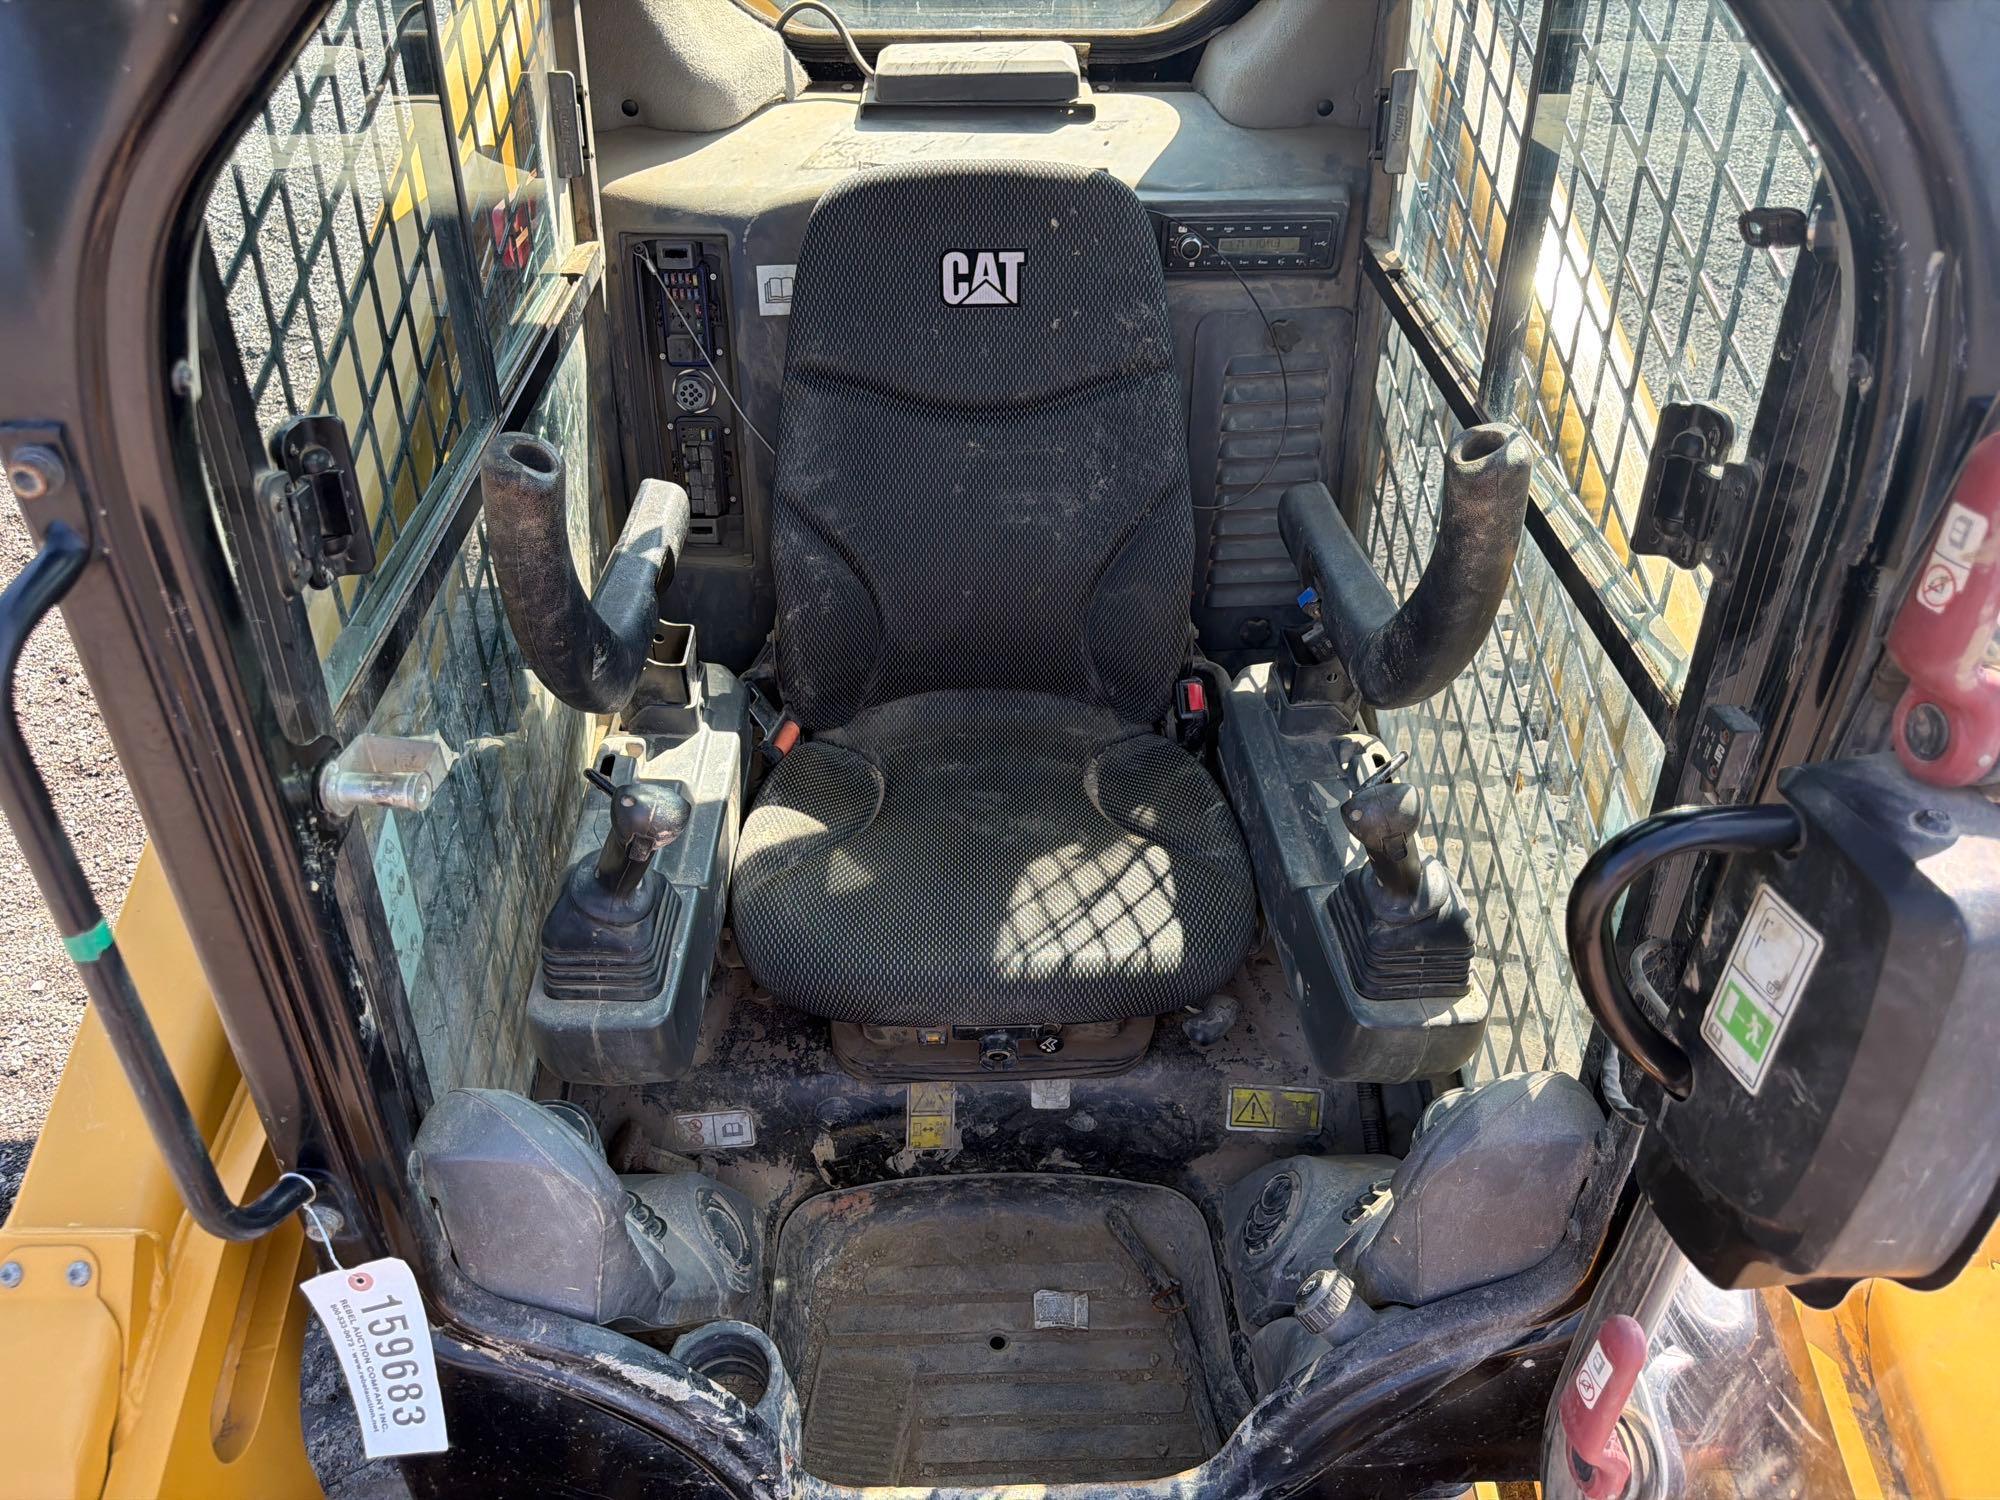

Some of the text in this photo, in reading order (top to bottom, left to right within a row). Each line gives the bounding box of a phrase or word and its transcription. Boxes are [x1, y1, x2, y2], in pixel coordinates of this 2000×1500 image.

[942, 251, 1025, 305] CAT
[1714, 743, 1725, 768] CAT
[340, 1298, 389, 1433] REBEL AUCTION COMPANY INC.
[361, 1294, 426, 1426] 159683
